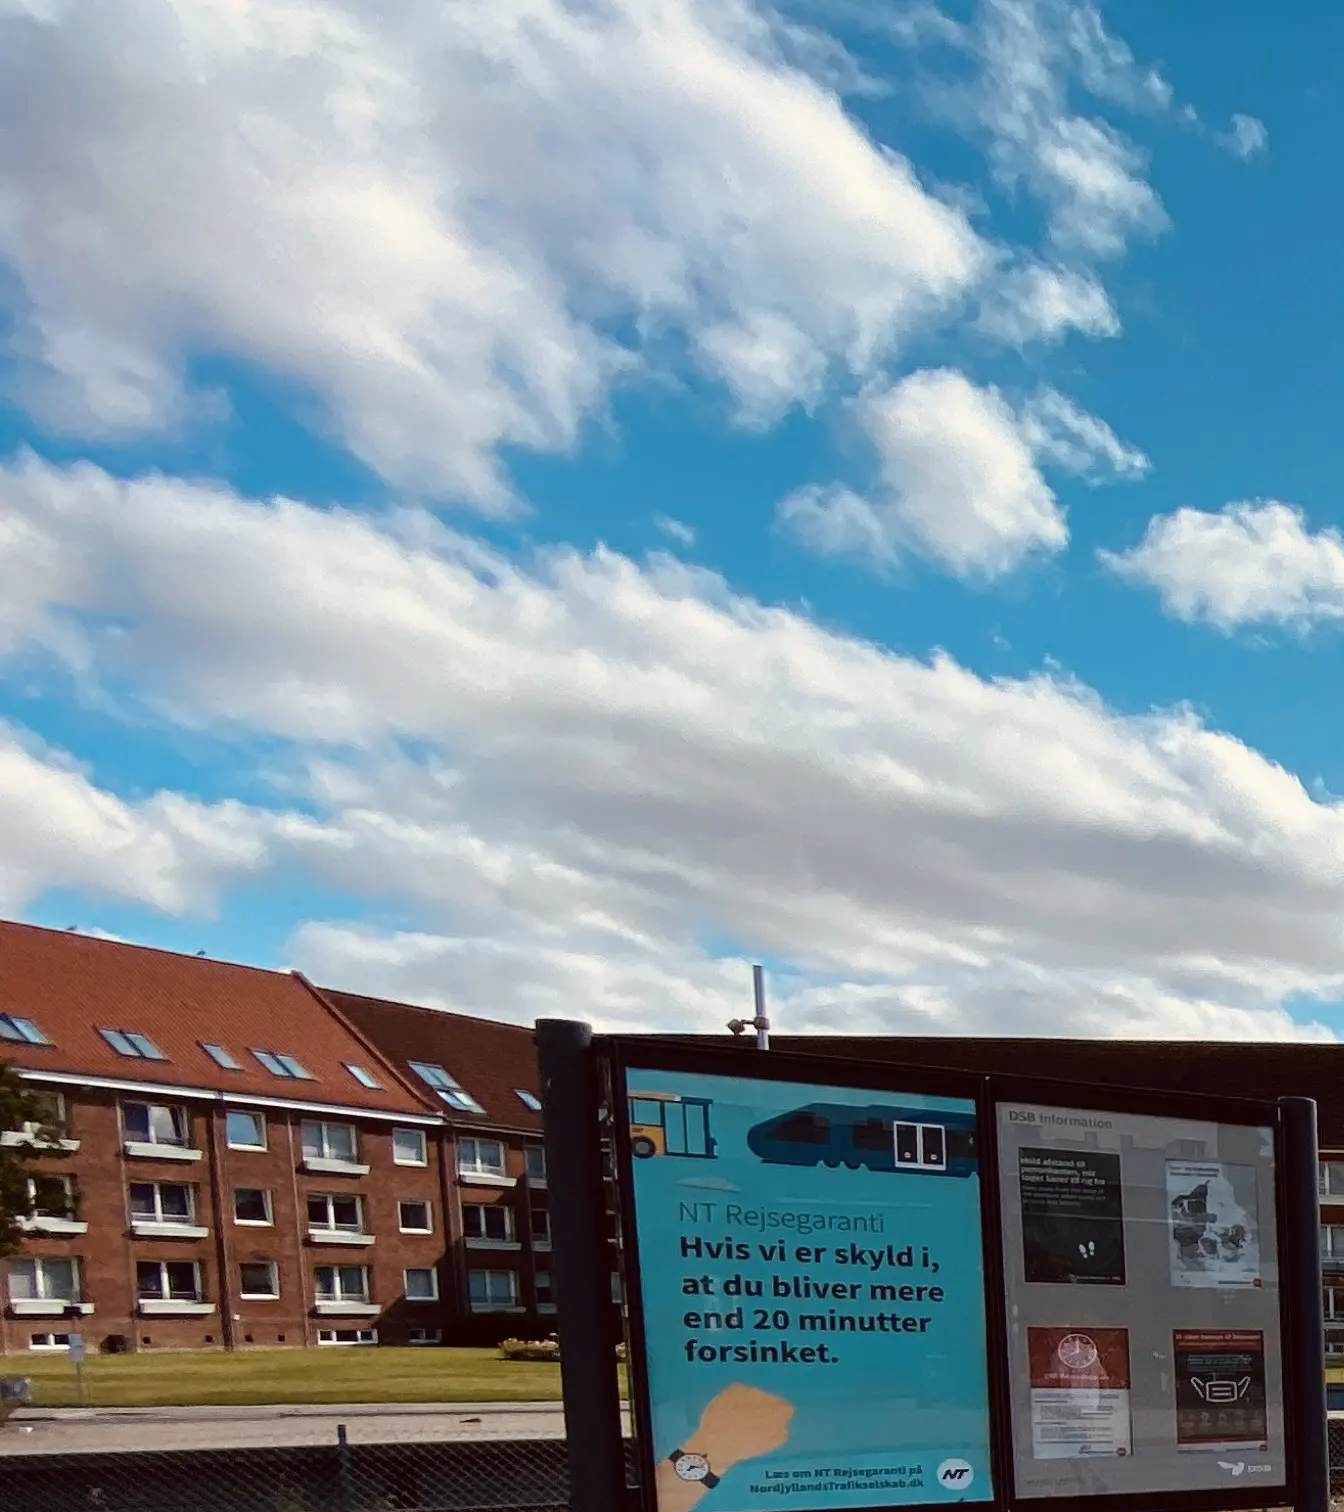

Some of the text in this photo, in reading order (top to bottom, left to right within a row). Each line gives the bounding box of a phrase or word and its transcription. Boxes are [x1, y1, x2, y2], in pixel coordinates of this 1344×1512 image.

[1008, 1110, 1036, 1123] DSB
[679, 1202, 885, 1235] NT Rejsegaranti
[680, 1236, 940, 1273] Hvis vi er skyld i,
[682, 1274, 945, 1302] at du bliver mere
[683, 1306, 932, 1333] end 20 minutter
[684, 1338, 840, 1364] forsinket.
[765, 1464, 923, 1481] Læs om NT Rejsegaranti på
[942, 1468, 970, 1480] NT
